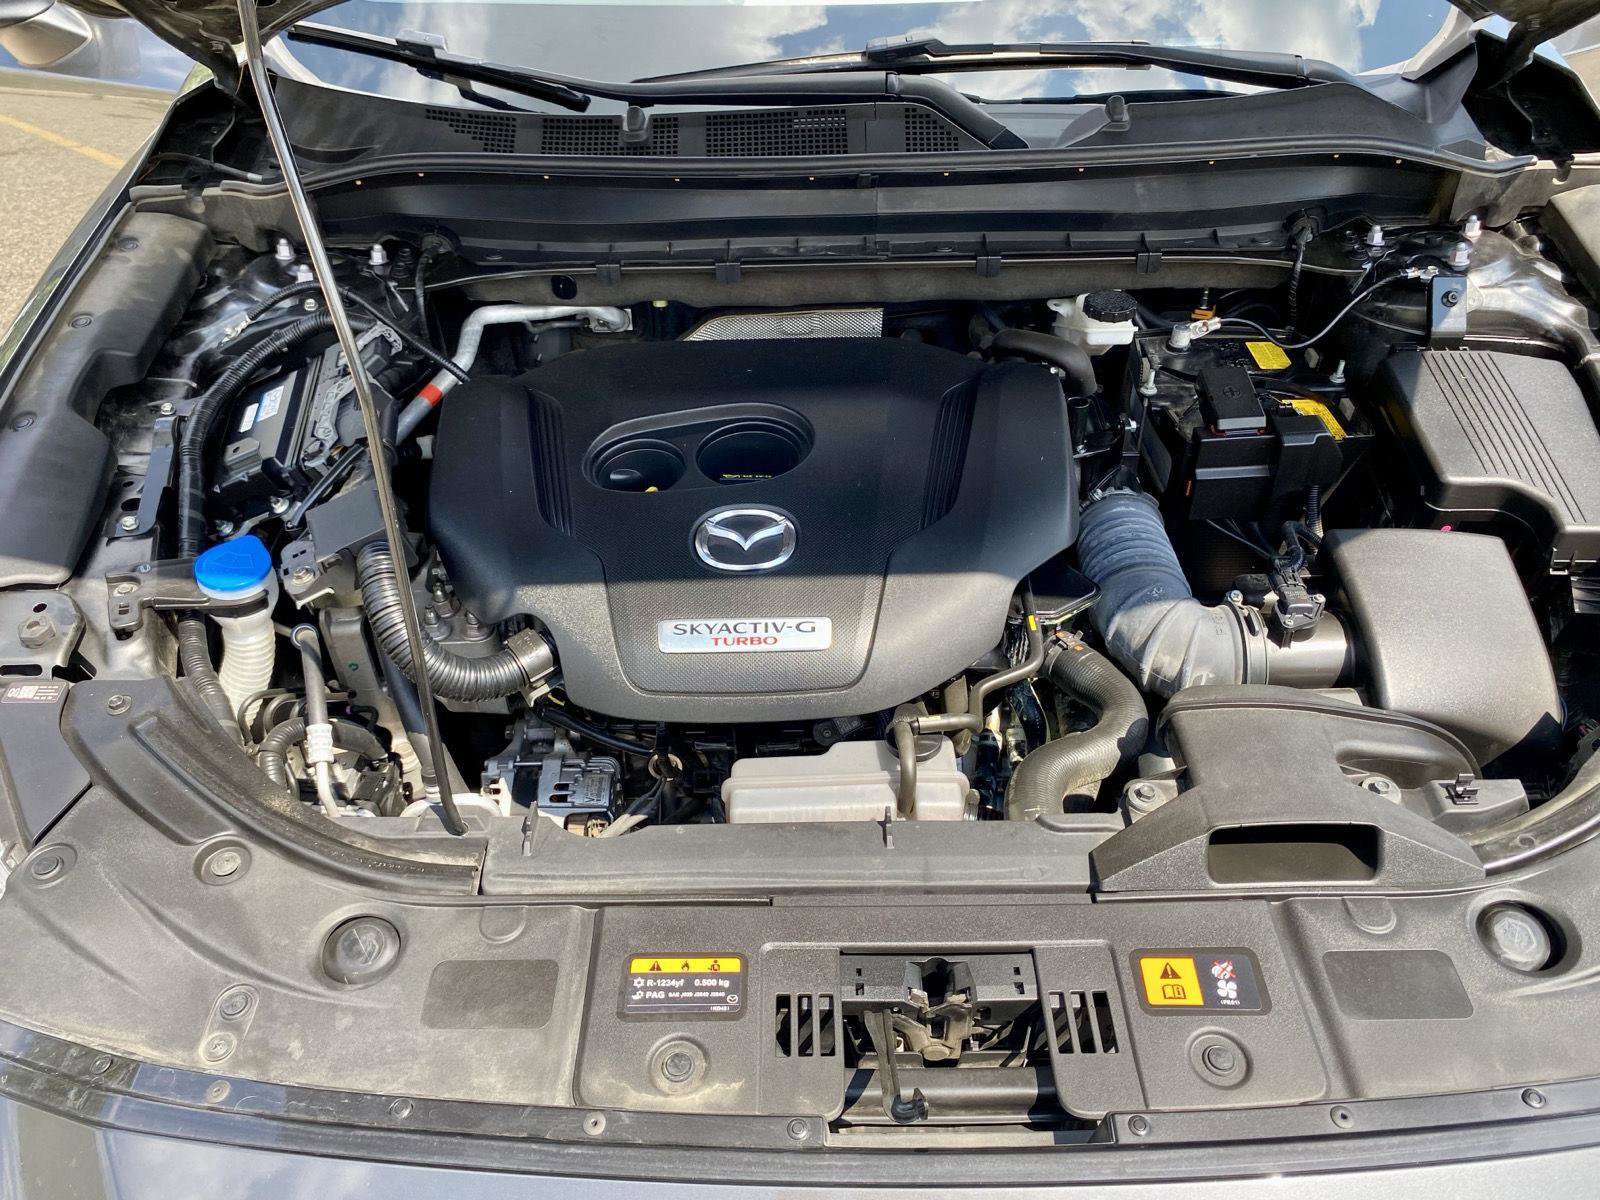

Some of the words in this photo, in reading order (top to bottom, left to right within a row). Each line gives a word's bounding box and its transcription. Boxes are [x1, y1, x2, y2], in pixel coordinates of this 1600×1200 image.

[673, 621, 816, 635] SKYACTIV-G
[711, 636, 778, 646] TURBO
[646, 979, 684, 988] R-1234yf
[694, 979, 717, 987] 0.500
[718, 979, 730, 988] kg
[645, 991, 665, 999] PAG
